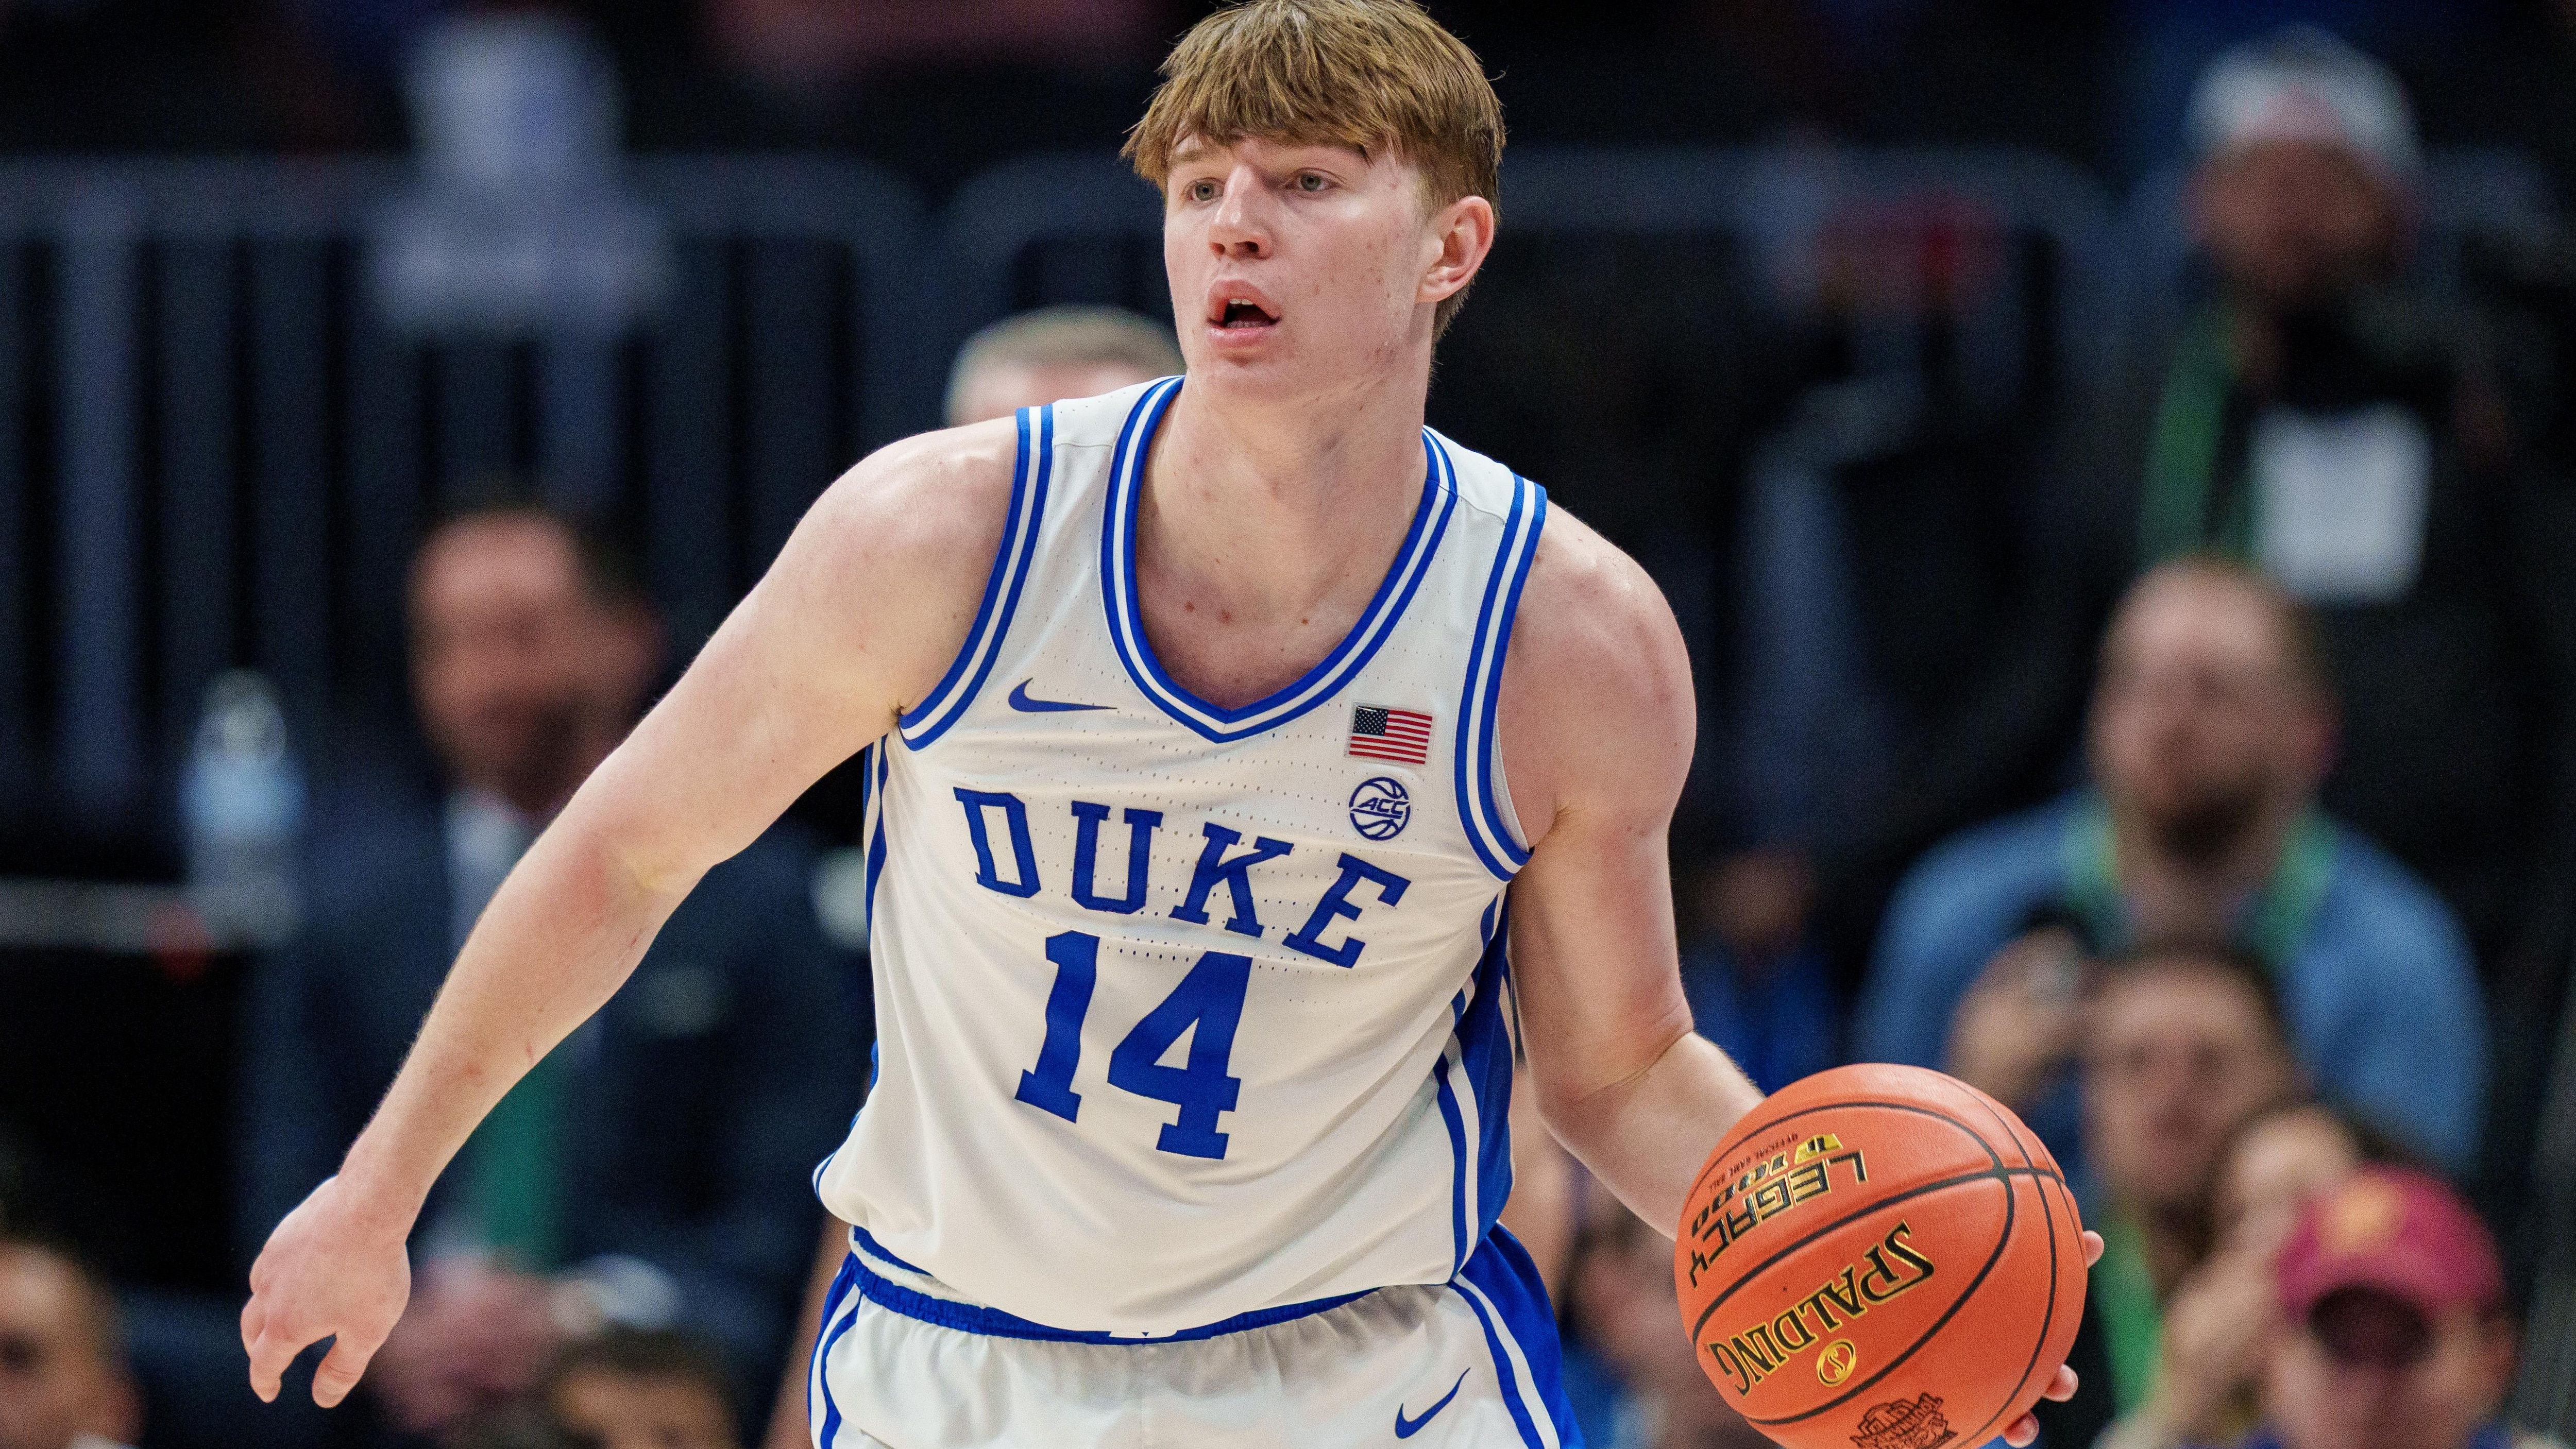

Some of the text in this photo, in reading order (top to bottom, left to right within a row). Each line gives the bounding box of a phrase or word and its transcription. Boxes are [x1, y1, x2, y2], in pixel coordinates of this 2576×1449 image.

[953, 786, 1411, 969] DUKE
[1358, 797, 1409, 816] ACC
[1014, 930, 1253, 1160] 14
[1689, 1149, 1869, 1289] LEGACY
[1708, 1219, 1935, 1396] SPALDING
